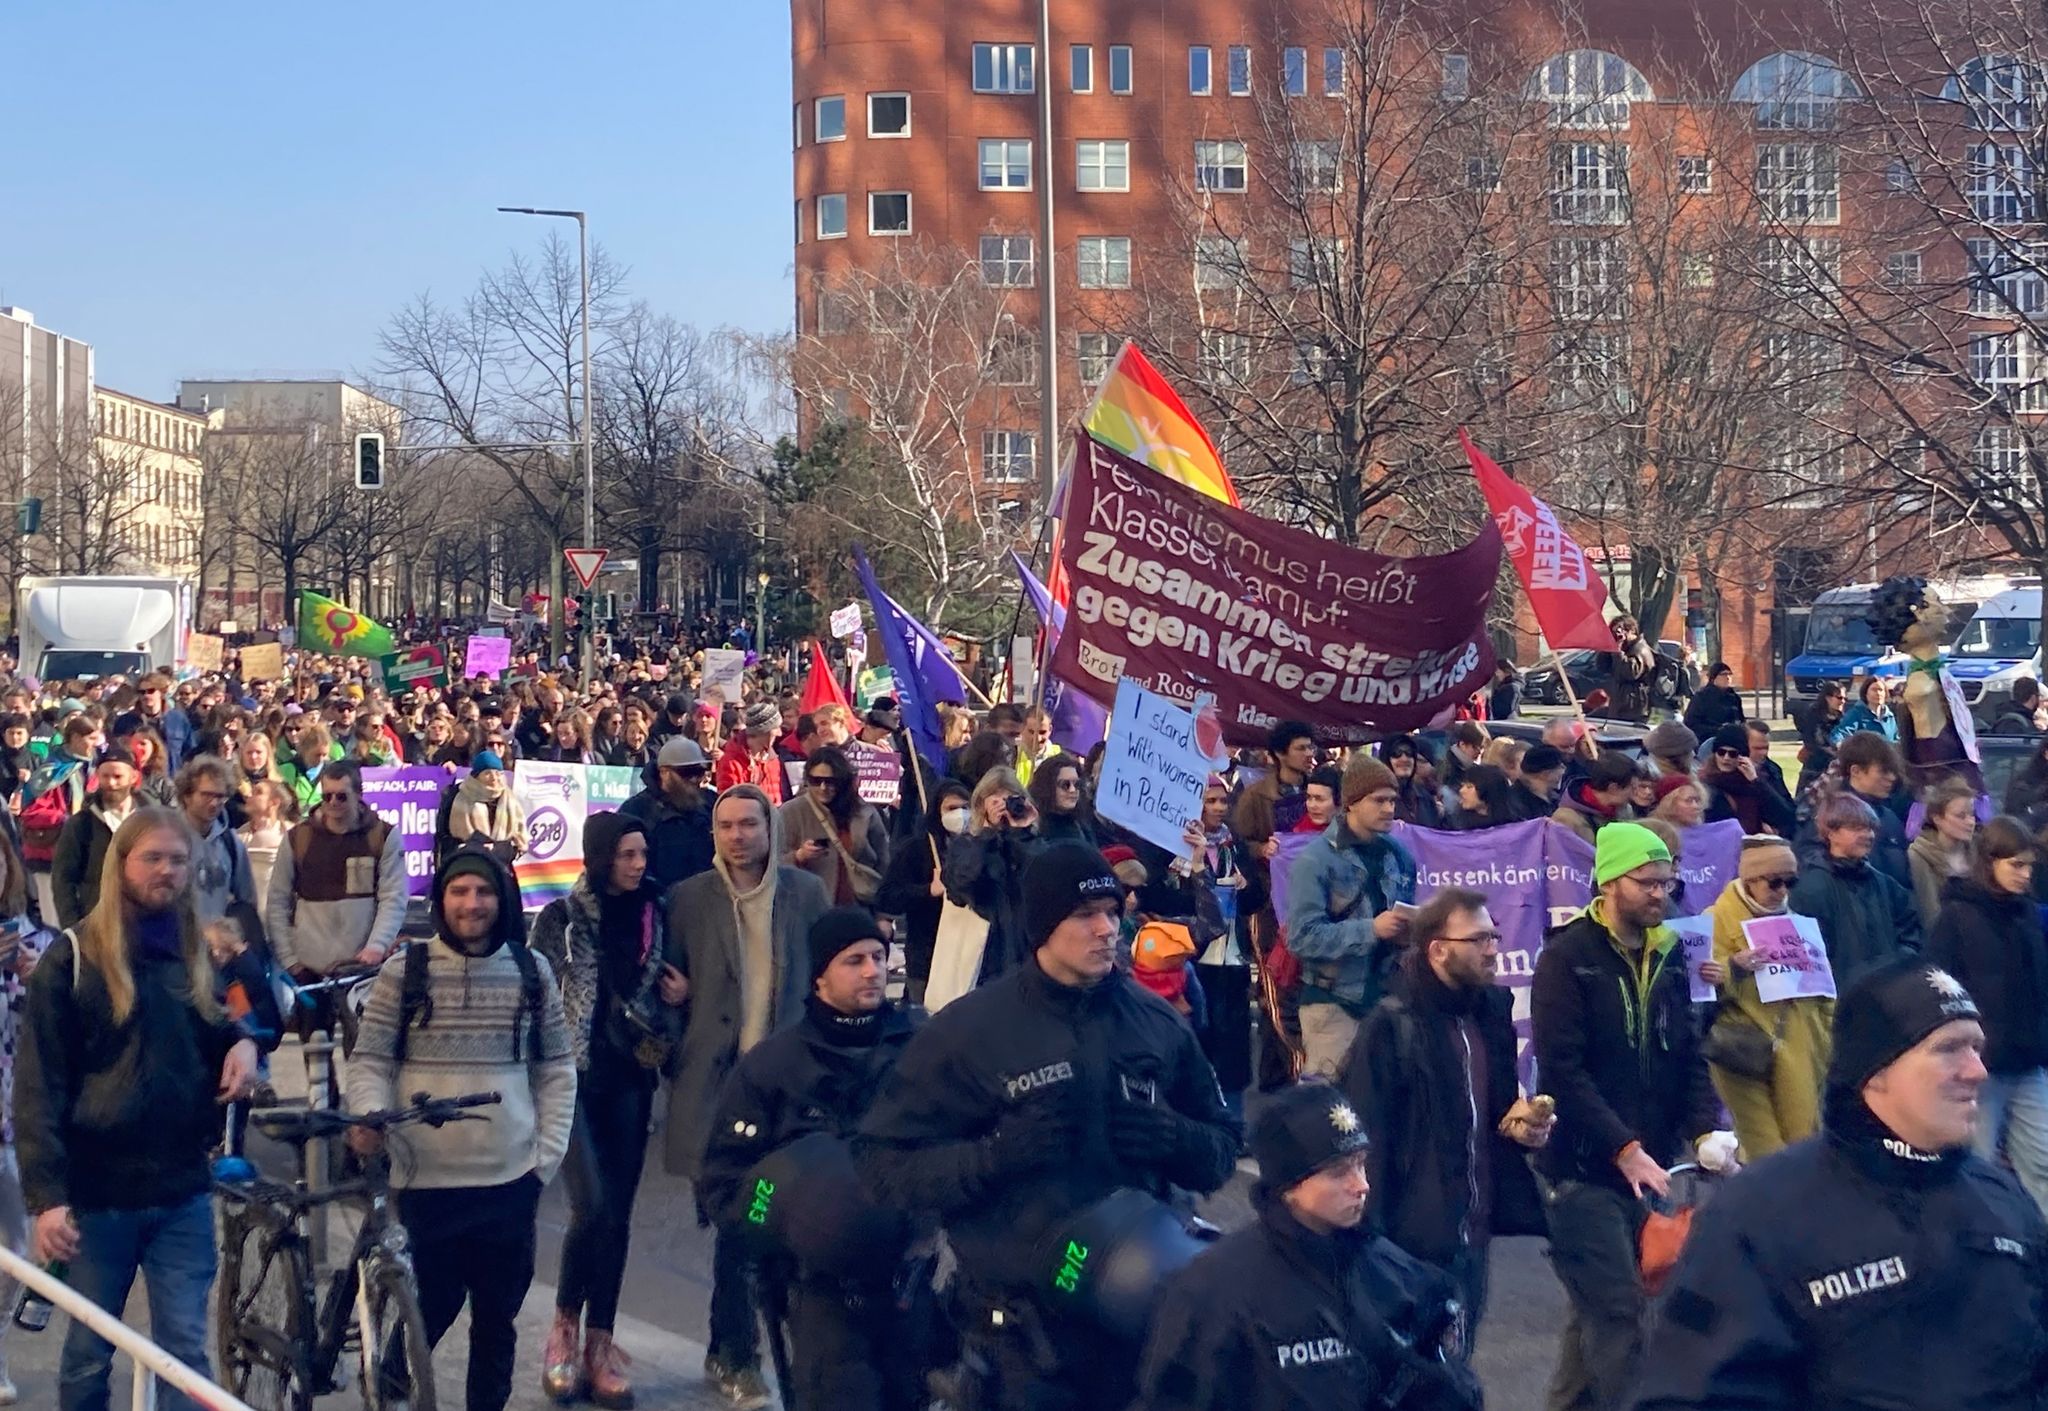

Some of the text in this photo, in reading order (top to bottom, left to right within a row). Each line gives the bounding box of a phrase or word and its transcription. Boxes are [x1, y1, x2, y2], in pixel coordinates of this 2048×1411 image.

[1077, 531, 1313, 657] Zusammen
[1317, 560, 1417, 604] heißt
[1076, 586, 1210, 658] gegen
[1217, 631, 1337, 703] Krieg
[1340, 675, 1411, 705] und
[1081, 645, 1119, 680] Brot
[1134, 693, 1190, 750] I stand
[408, 780, 438, 791] FAIR:
[1113, 769, 1193, 829] in Palestin
[1158, 753, 1204, 799] women
[1007, 1061, 1073, 1097] POLIZEI
[1056, 1240, 1088, 1293] 2/42
[1808, 1255, 1907, 1307] POLIZEI
